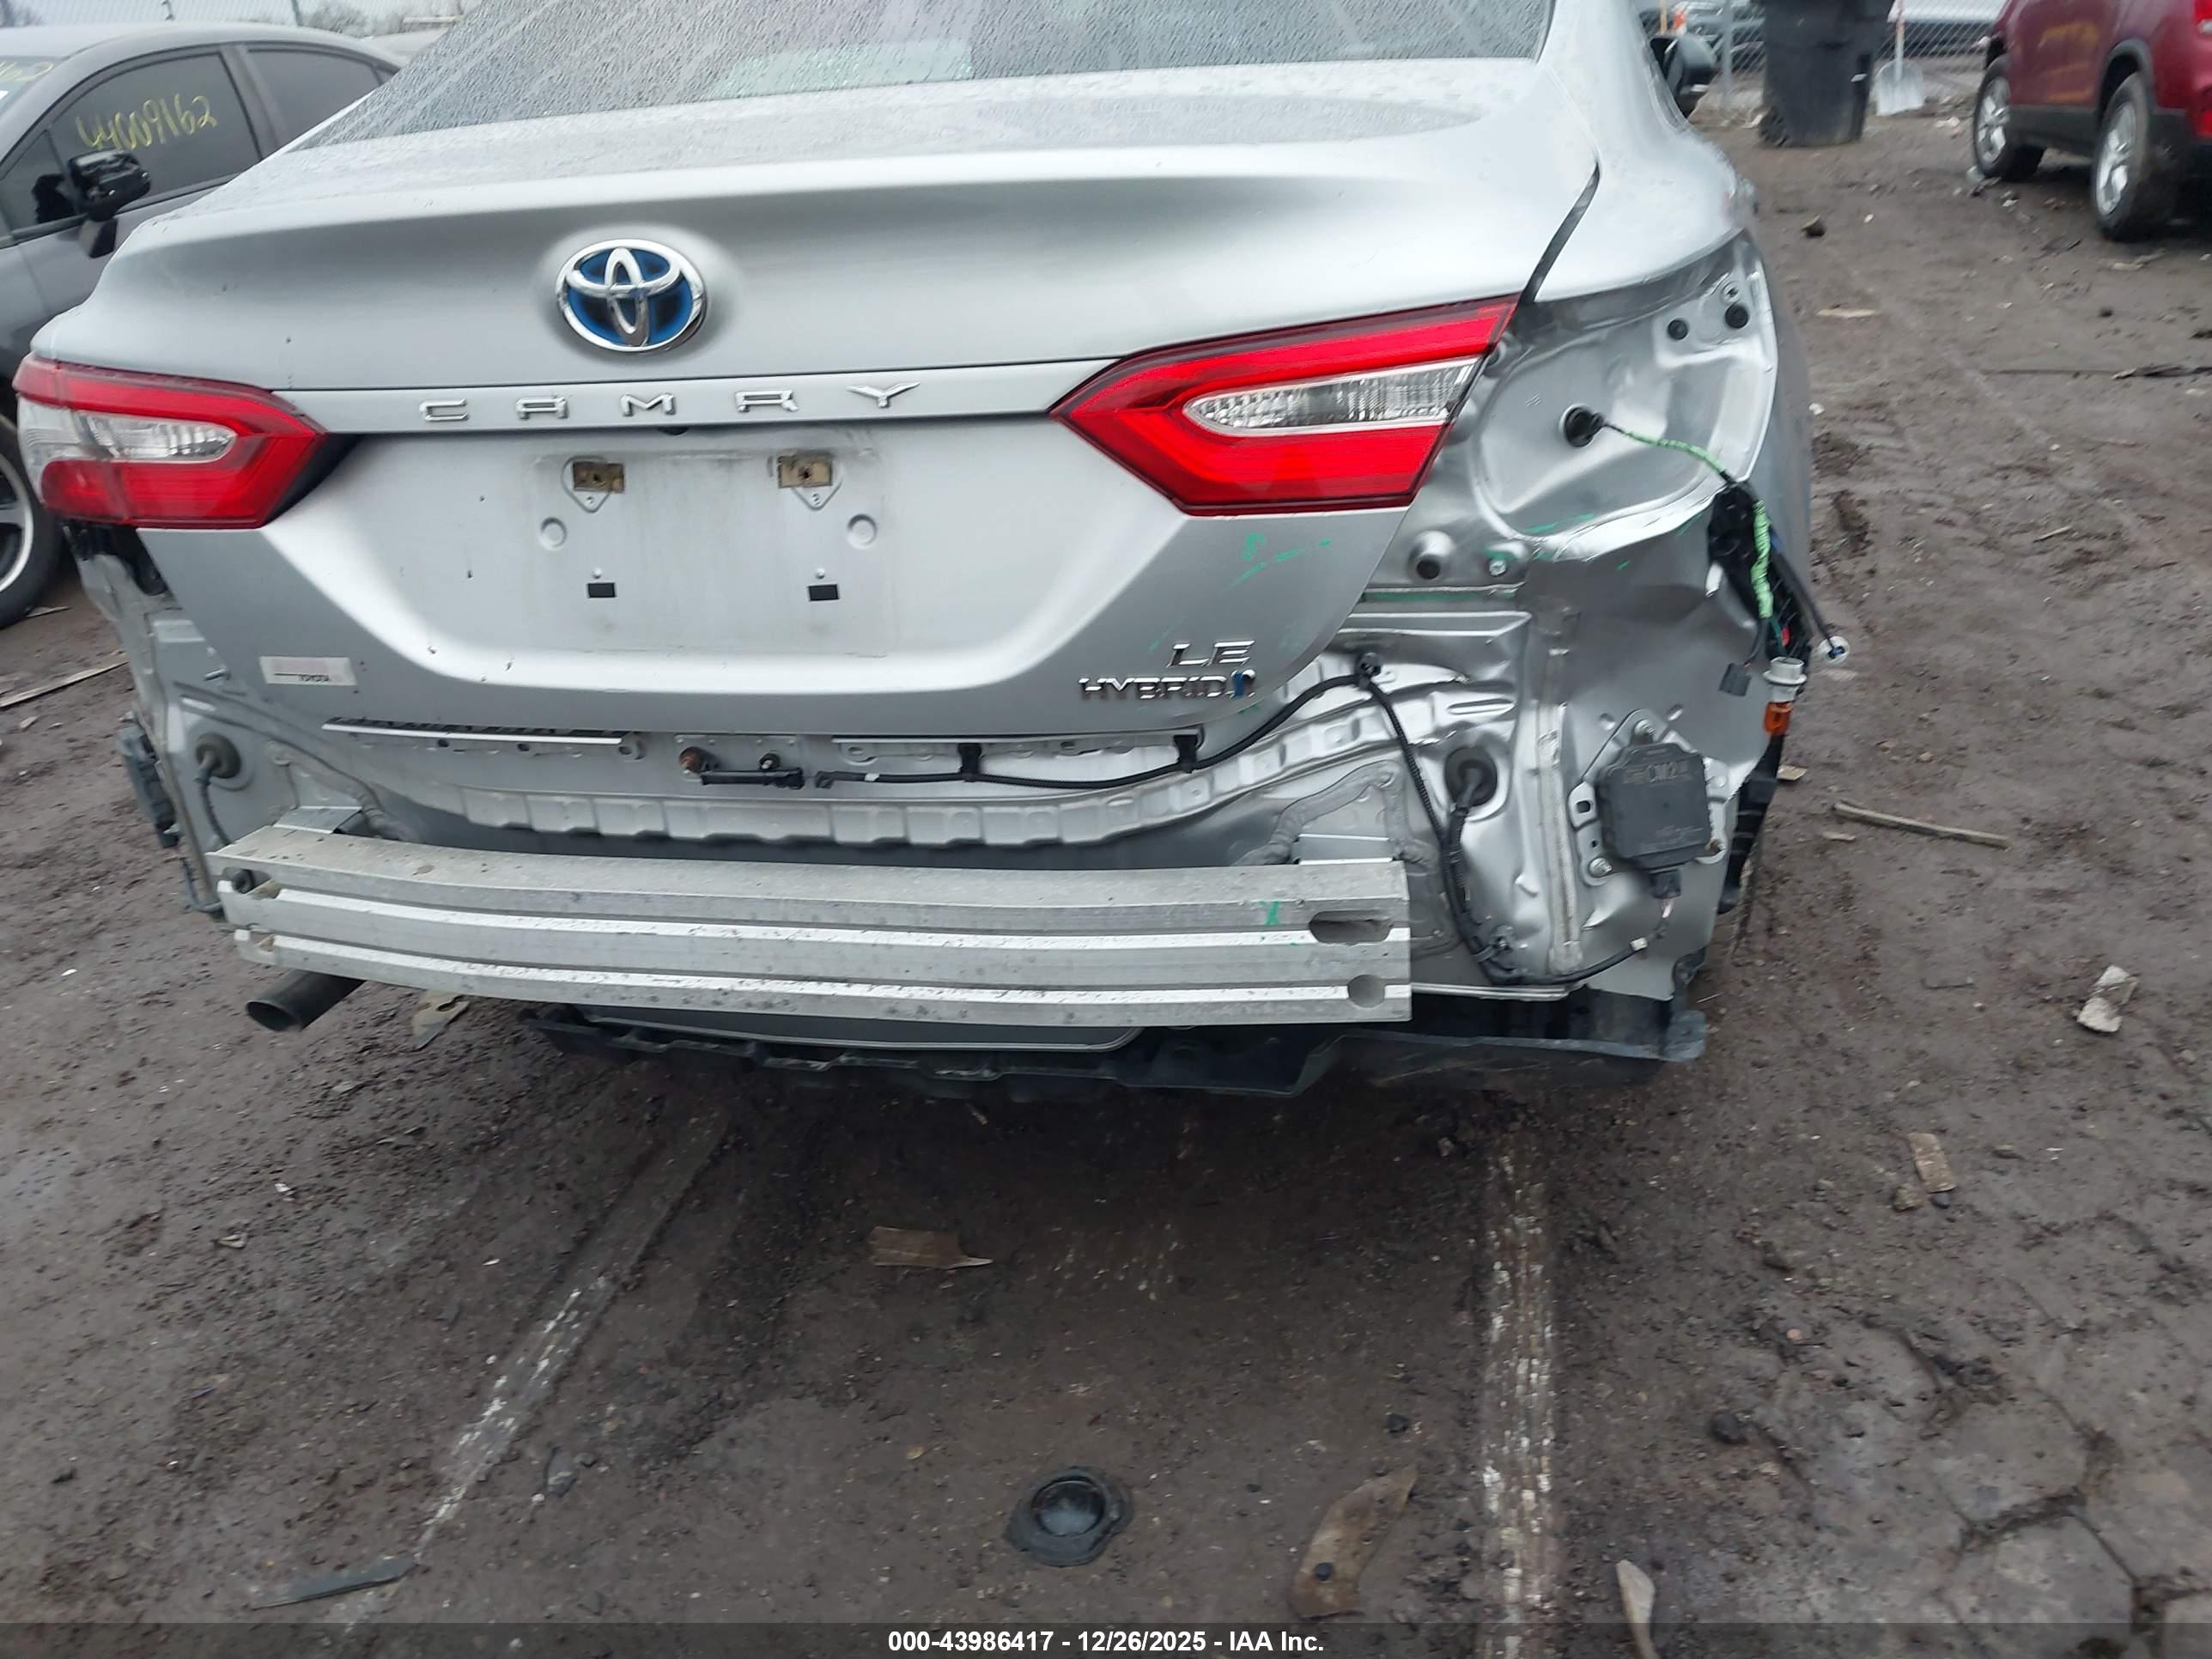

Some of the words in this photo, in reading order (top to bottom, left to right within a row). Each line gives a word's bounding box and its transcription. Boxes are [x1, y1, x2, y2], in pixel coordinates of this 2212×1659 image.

[418, 380, 921, 422] CAMRY
[1165, 641, 1255, 668] LE
[1078, 675, 1227, 701] HYBRID
